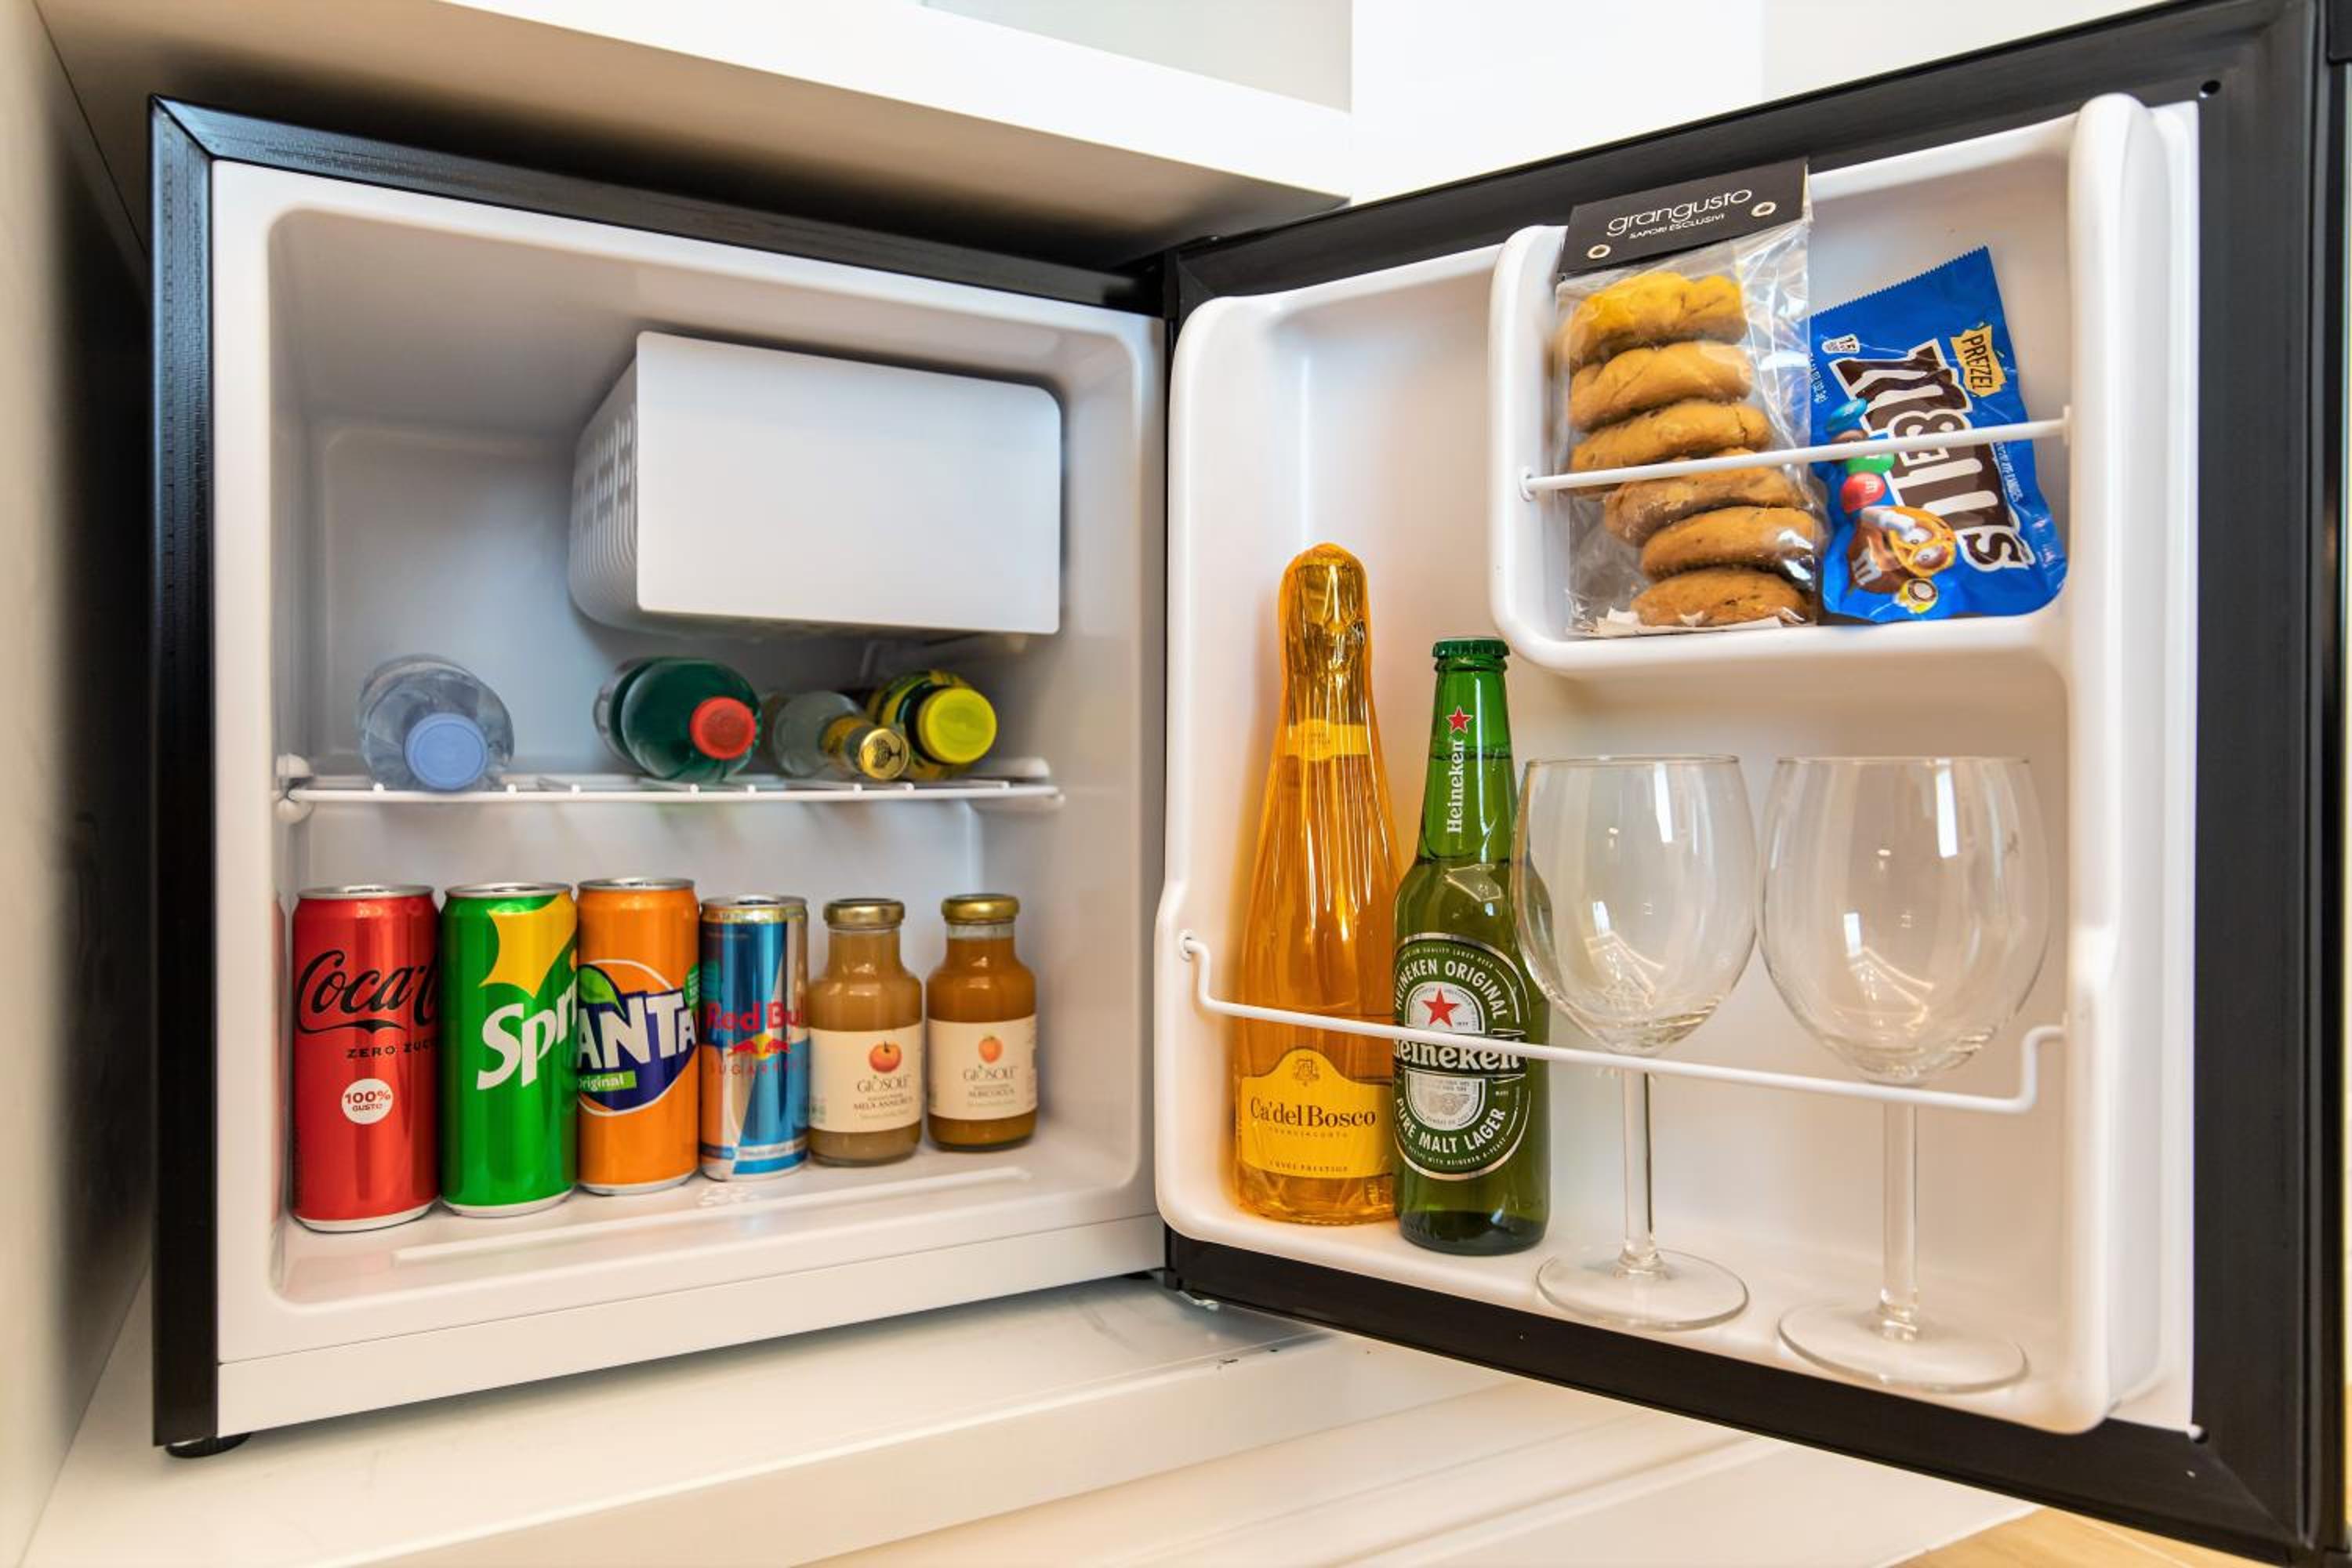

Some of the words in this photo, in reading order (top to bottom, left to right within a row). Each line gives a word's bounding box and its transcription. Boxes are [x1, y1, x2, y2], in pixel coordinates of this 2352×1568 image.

[1606, 189, 1752, 237] grangusto
[1629, 226, 1668, 239] SAPORI
[1669, 212, 1726, 232] ESCLUSIVI
[1962, 333, 1994, 390] PRETZEL
[1446, 739, 1465, 833] Heineken
[297, 949, 439, 1035] Coca-C
[1395, 958, 1439, 1011] HEINEKEN
[1445, 960, 1508, 1020] ORIGINAL
[577, 991, 697, 1069] ANTA
[706, 1001, 760, 1032] Red
[347, 1045, 397, 1059] ZERO
[344, 1090, 391, 1105] 100%
[352, 1103, 383, 1112] GUSTO
[1396, 1098, 1417, 1139] PURE
[1418, 1131, 1458, 1154] MALT
[1464, 1107, 1506, 1151] LAGER
